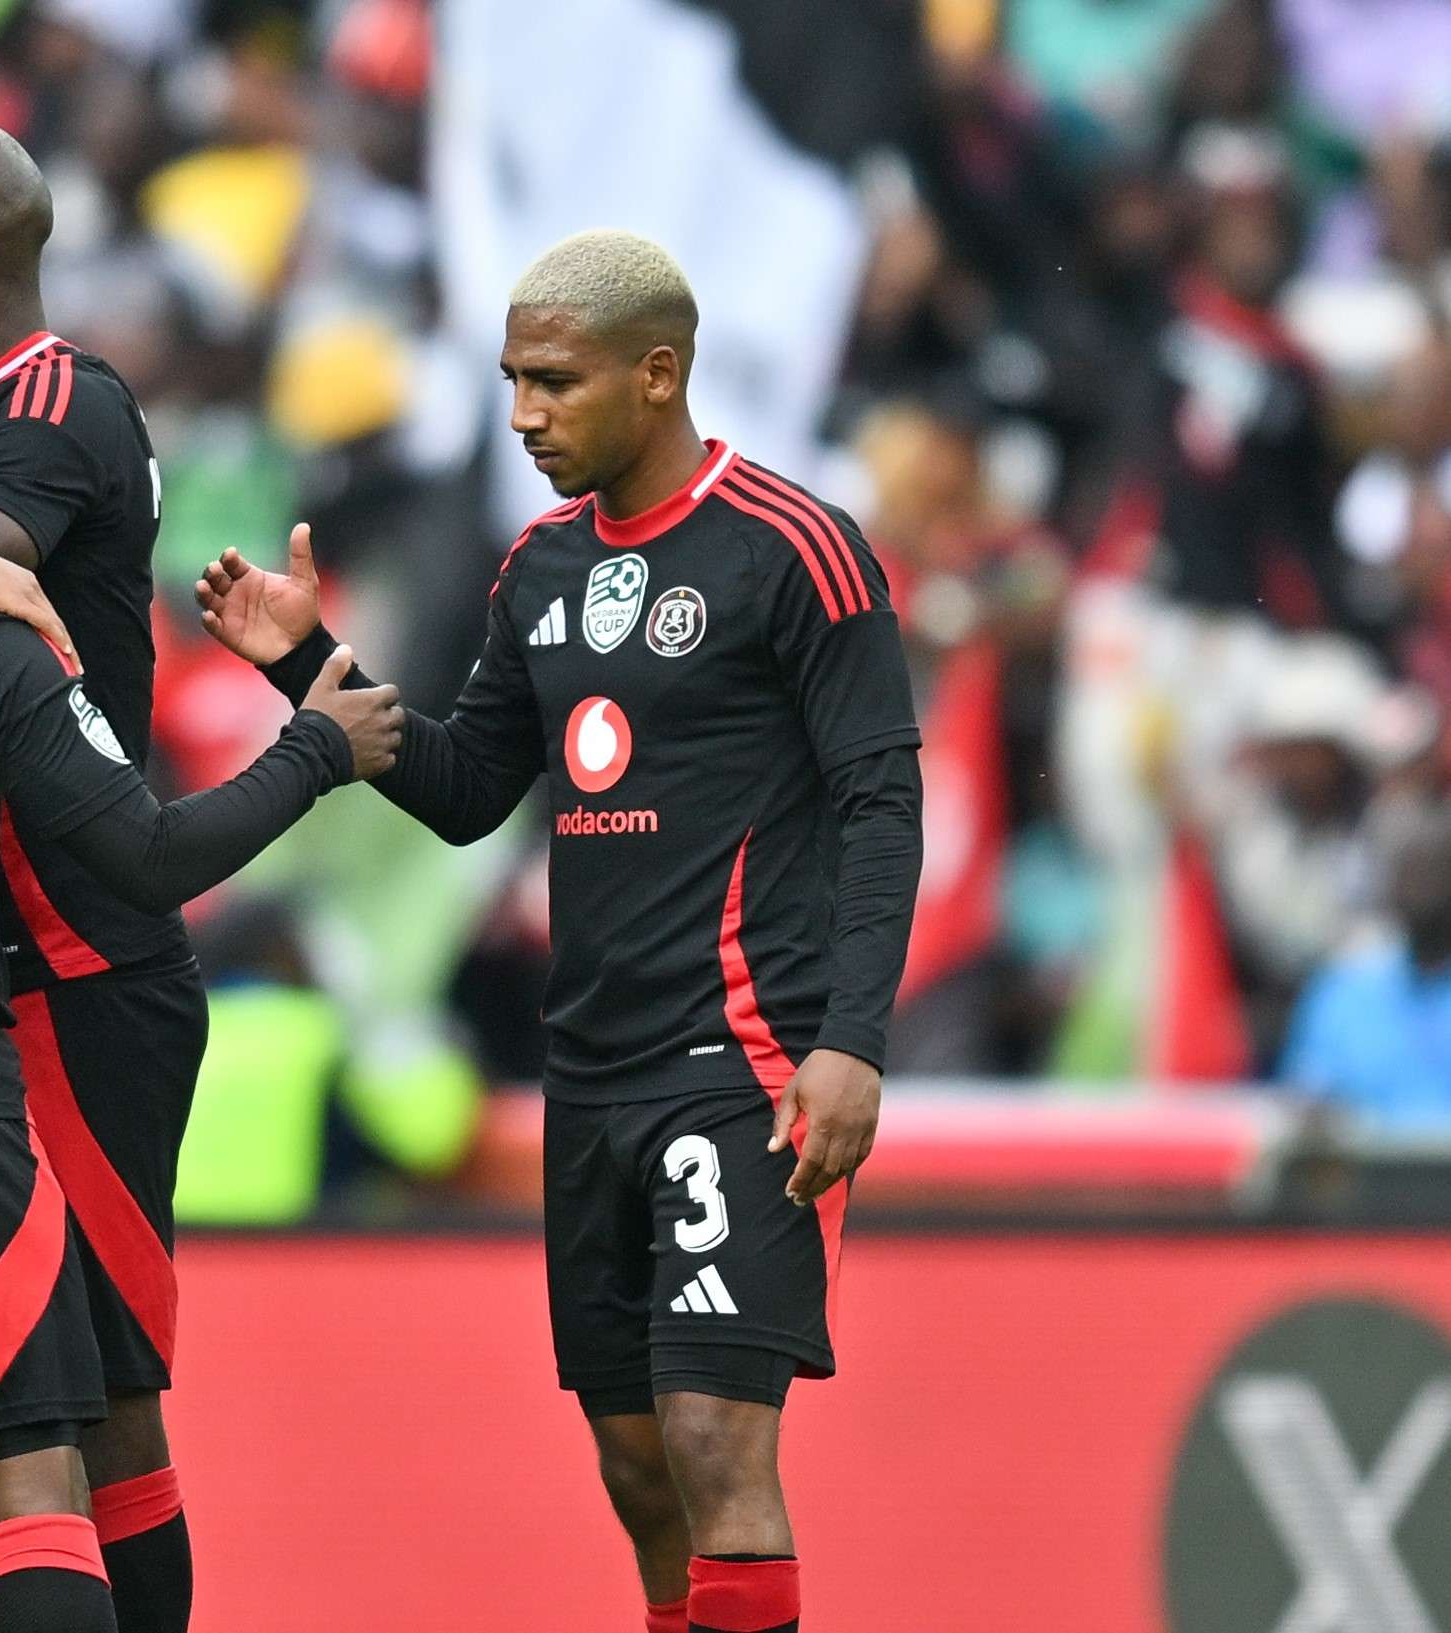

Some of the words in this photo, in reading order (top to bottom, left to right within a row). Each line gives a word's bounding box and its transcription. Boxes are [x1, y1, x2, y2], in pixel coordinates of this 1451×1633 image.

[591, 608, 632, 618] NEDBANK
[595, 619, 625, 633] CUP
[556, 805, 658, 836] vodacom
[663, 1135, 730, 1253] 3
